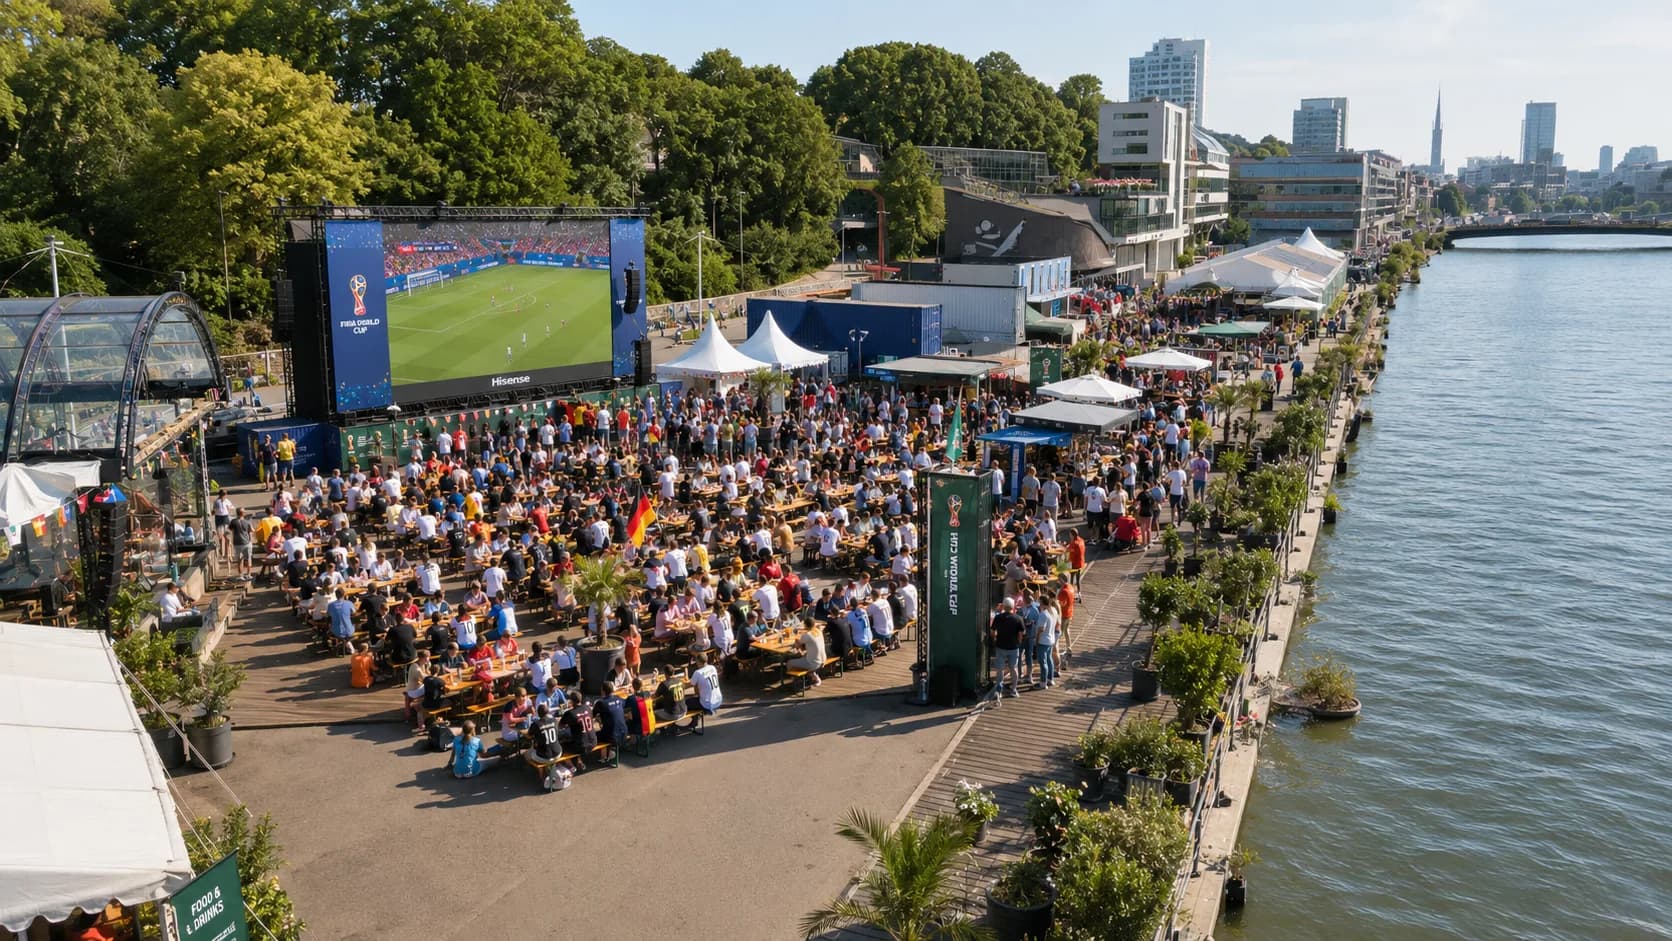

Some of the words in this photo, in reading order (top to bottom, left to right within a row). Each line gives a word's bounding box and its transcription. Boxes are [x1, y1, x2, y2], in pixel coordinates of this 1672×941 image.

[353, 326, 367, 334] CUP
[491, 375, 531, 387] Hisense
[705, 674, 719, 690] 10
[577, 716, 593, 733] 10
[541, 727, 557, 745] 10
[191, 891, 213, 916] FOOD
[193, 899, 224, 931] DRINKS
